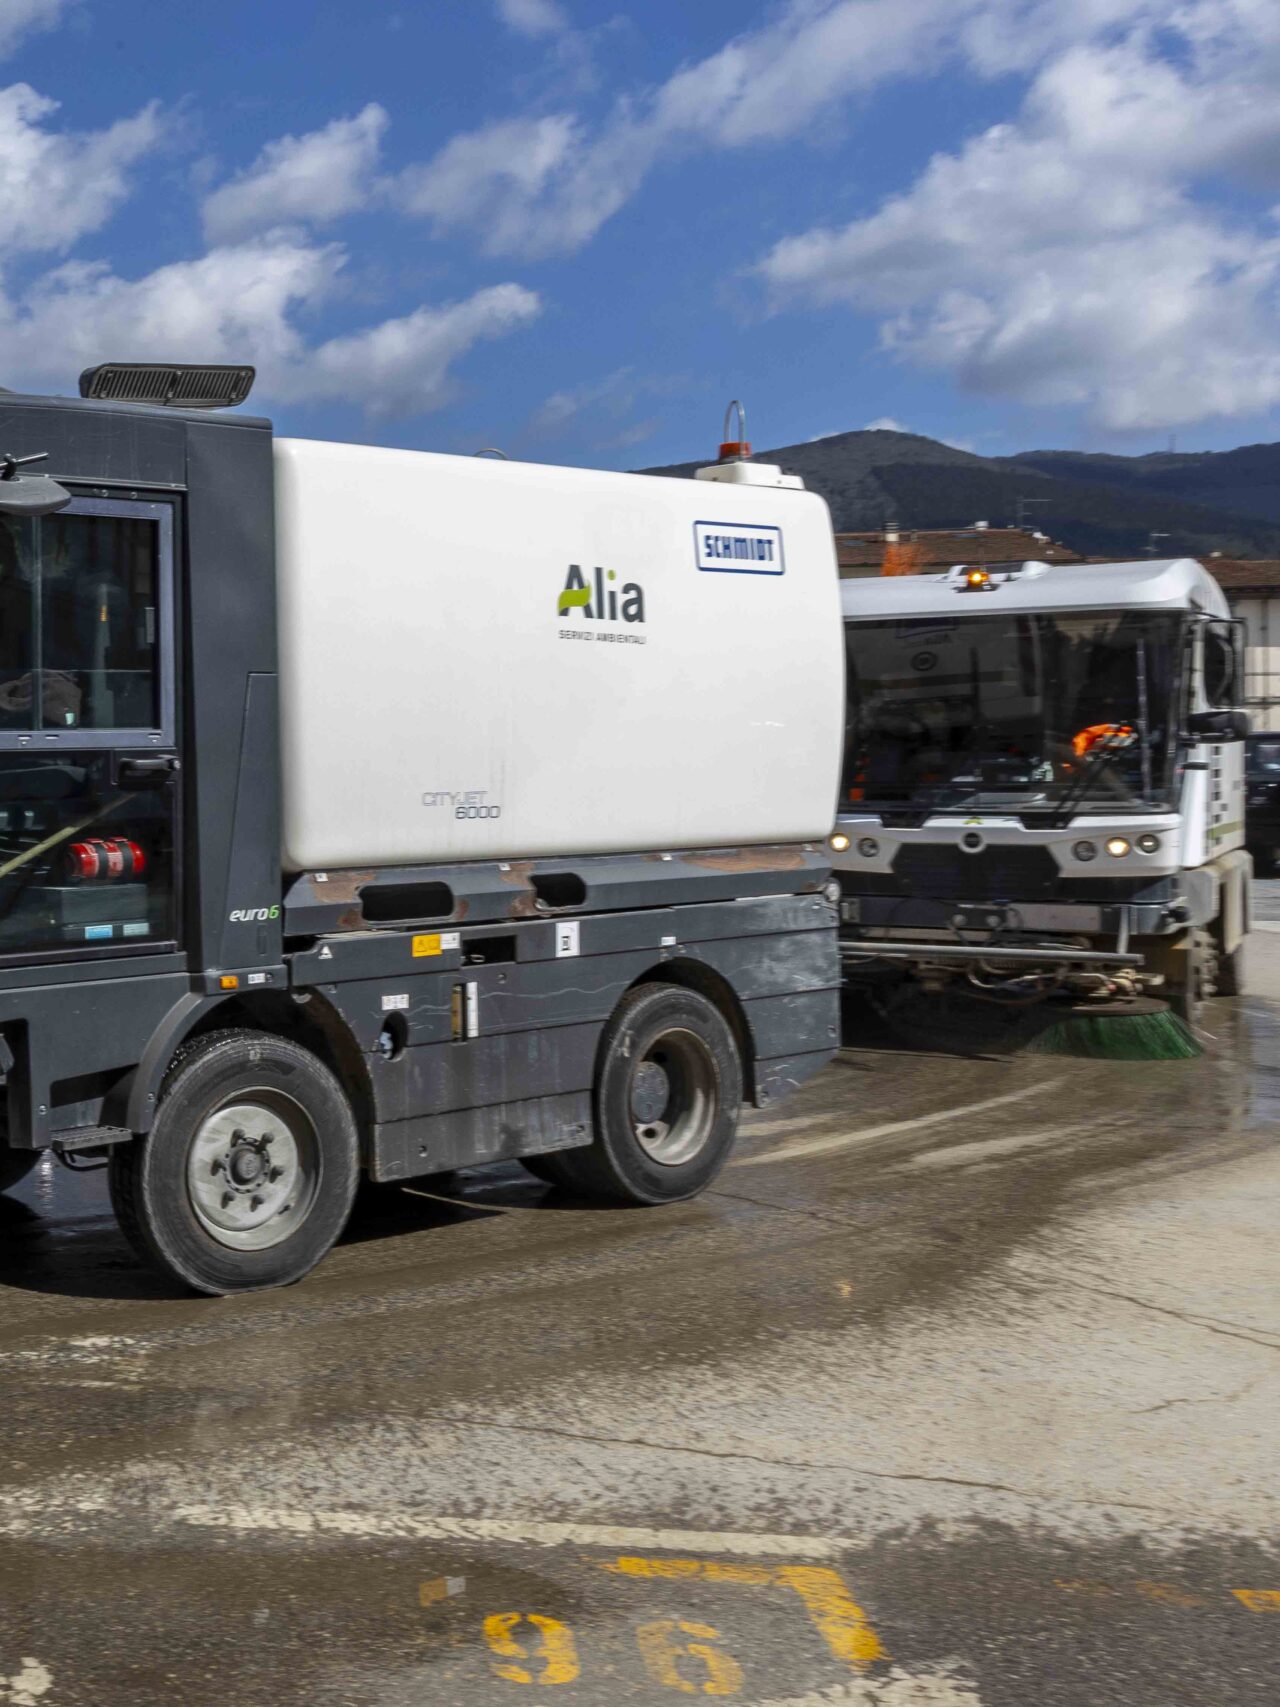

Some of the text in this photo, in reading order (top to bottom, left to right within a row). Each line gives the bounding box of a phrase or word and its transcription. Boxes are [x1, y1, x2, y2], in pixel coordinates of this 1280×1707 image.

[703, 534, 774, 561] SCHMIDT
[557, 564, 646, 623] Alia
[455, 805, 501, 819] 6000
[229, 904, 280, 922] euro6
